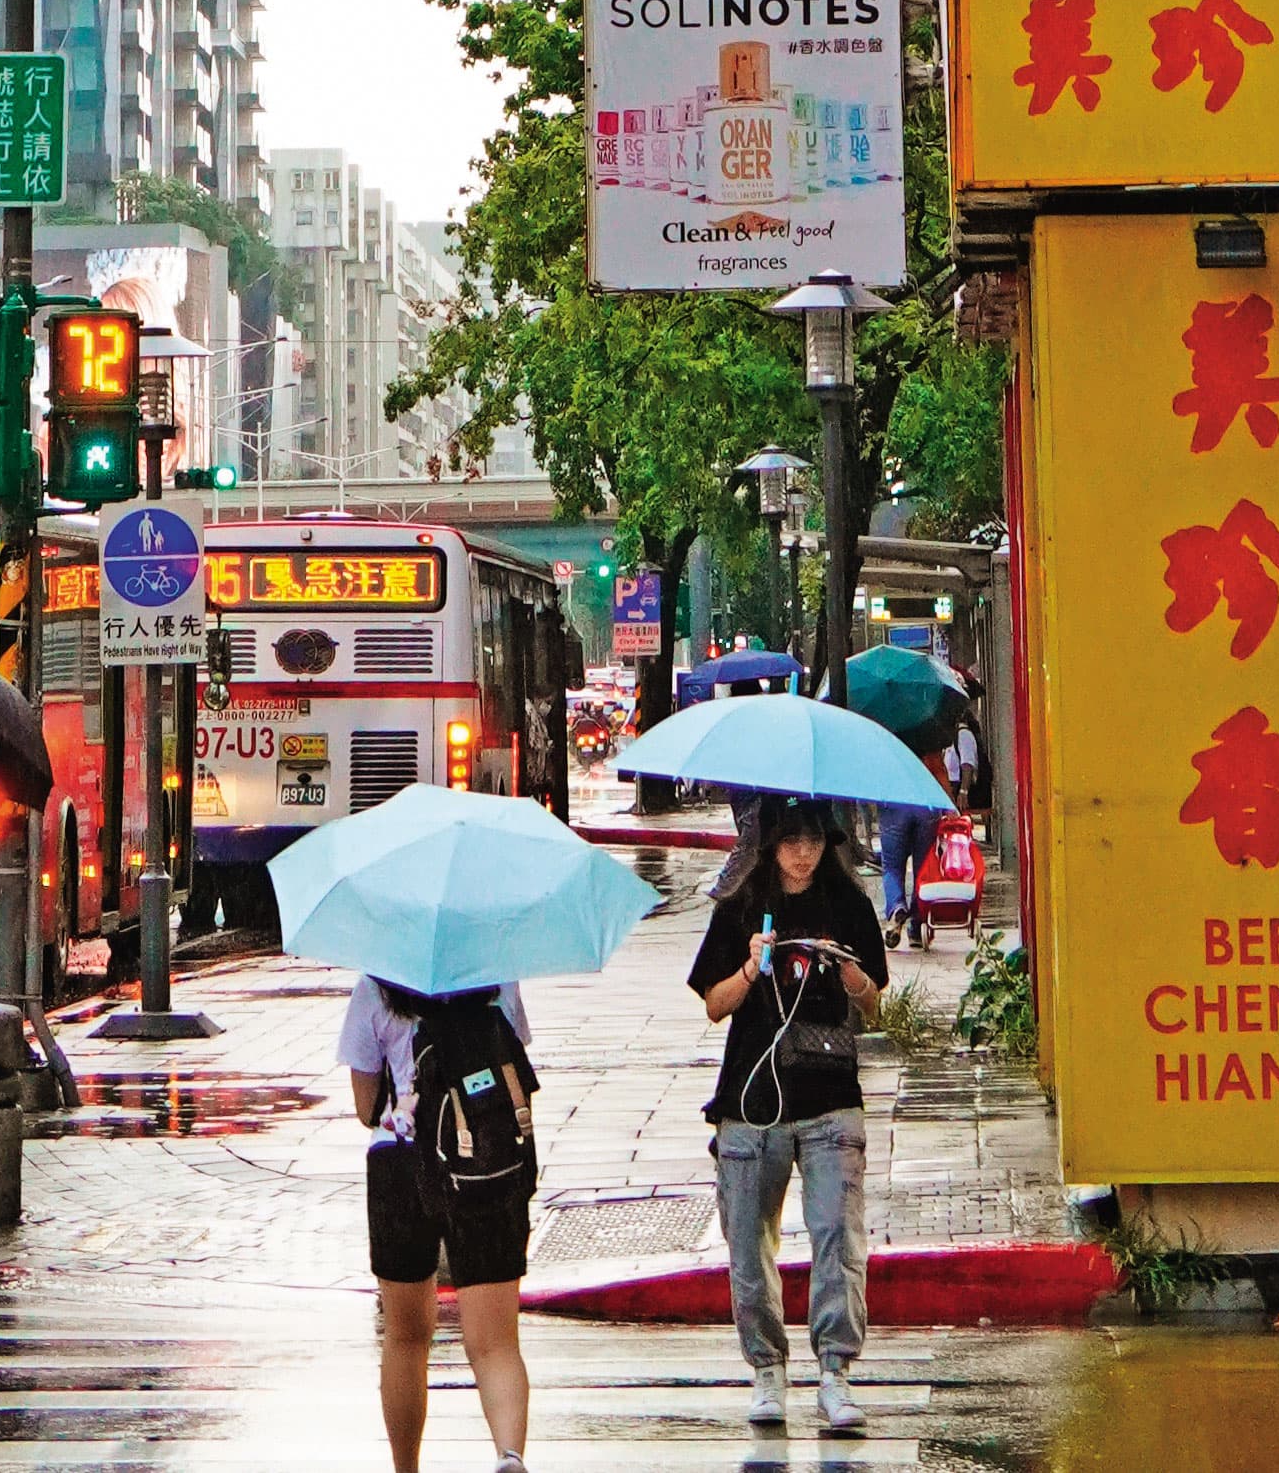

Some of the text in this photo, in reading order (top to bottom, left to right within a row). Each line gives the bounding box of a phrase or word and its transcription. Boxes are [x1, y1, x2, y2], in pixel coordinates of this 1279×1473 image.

[21, 65, 53, 197] 行人請依
[720, 148, 774, 180] GER
[662, 222, 730, 244] Clean
[792, 219, 836, 246] good
[698, 254, 788, 275] fragrances
[69, 323, 125, 393] 72
[103, 614, 203, 640] 行人優先
[195, 726, 275, 759] 97-U3
